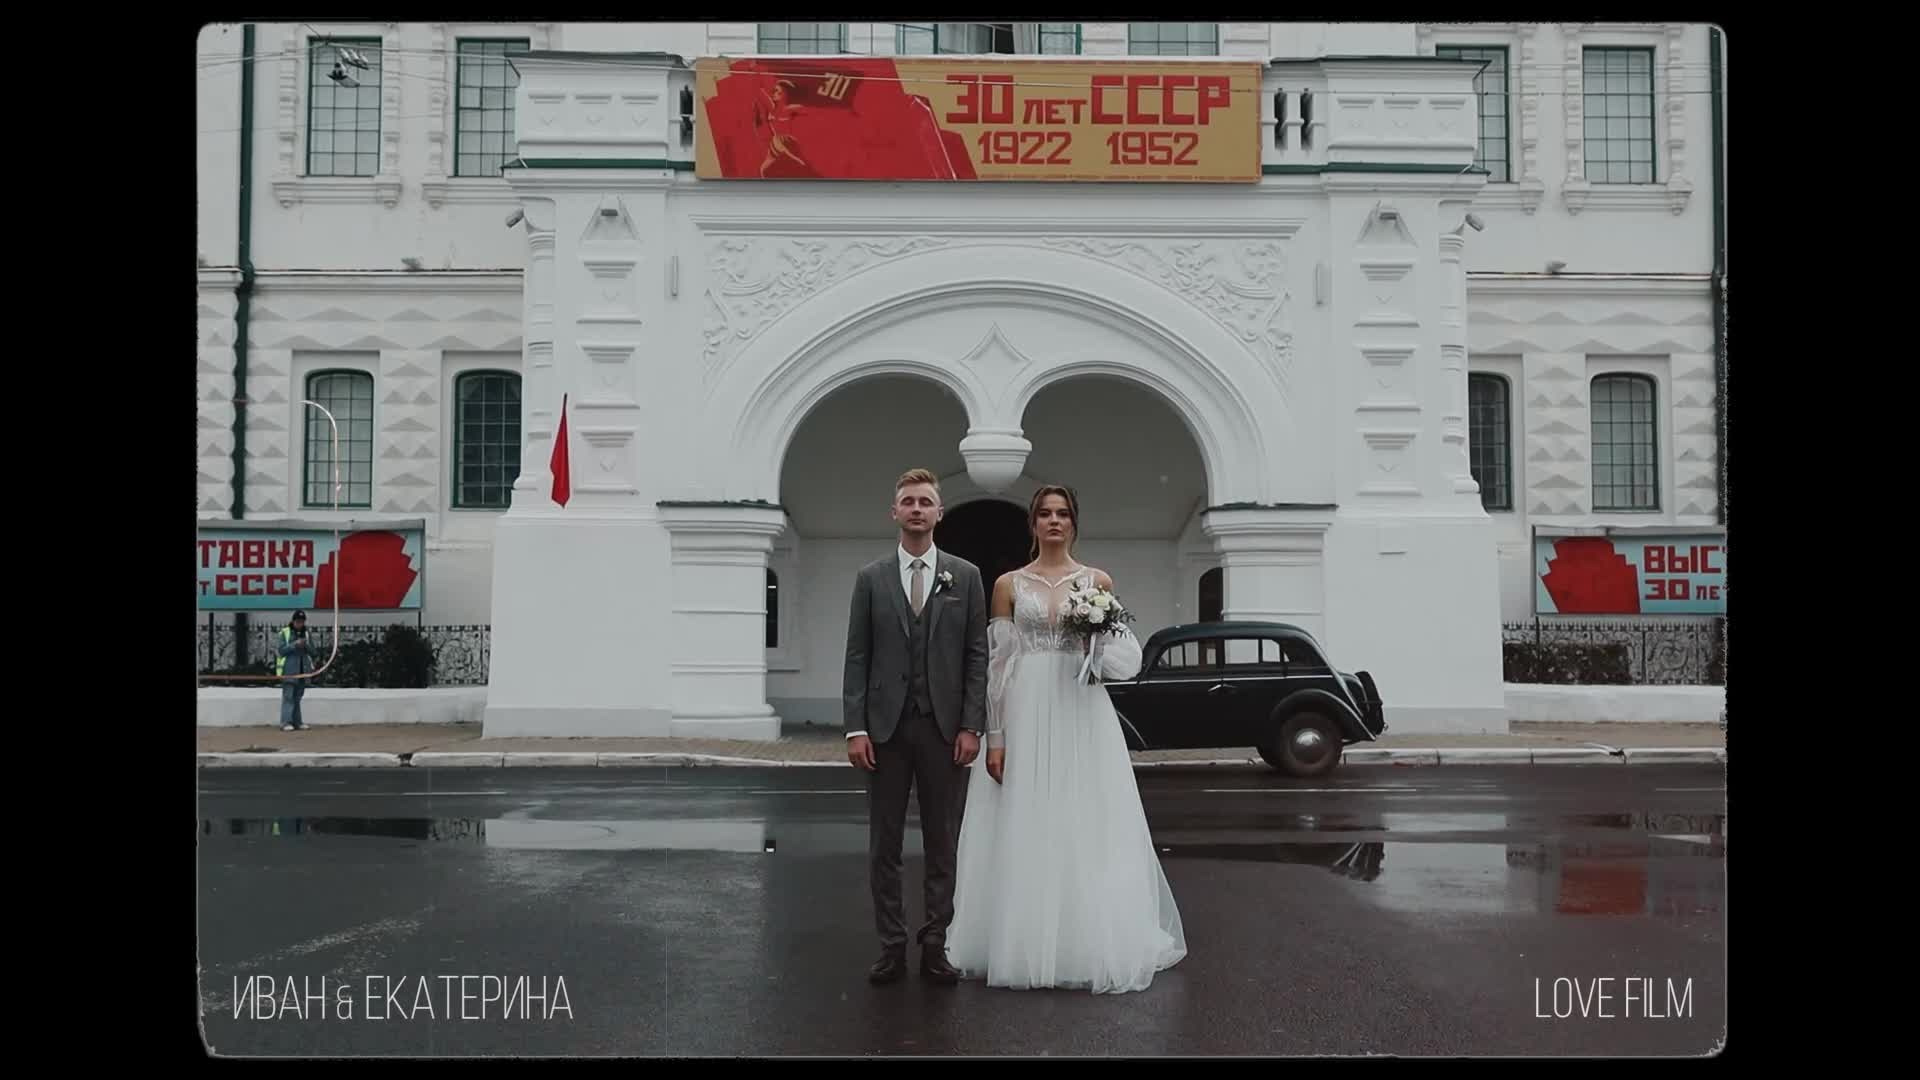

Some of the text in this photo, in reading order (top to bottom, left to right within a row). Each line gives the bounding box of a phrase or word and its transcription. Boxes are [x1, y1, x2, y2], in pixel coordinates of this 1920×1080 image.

[816, 72, 850, 100] 30
[946, 74, 1014, 124] 30
[1091, 75, 1231, 125] СССР
[977, 131, 1199, 166] 1922 1952
[198, 540, 314, 568] ТАВКА
[1643, 545, 1728, 573] ВЫС
[215, 574, 314, 596] СССР
[1644, 578, 1690, 600] 30
